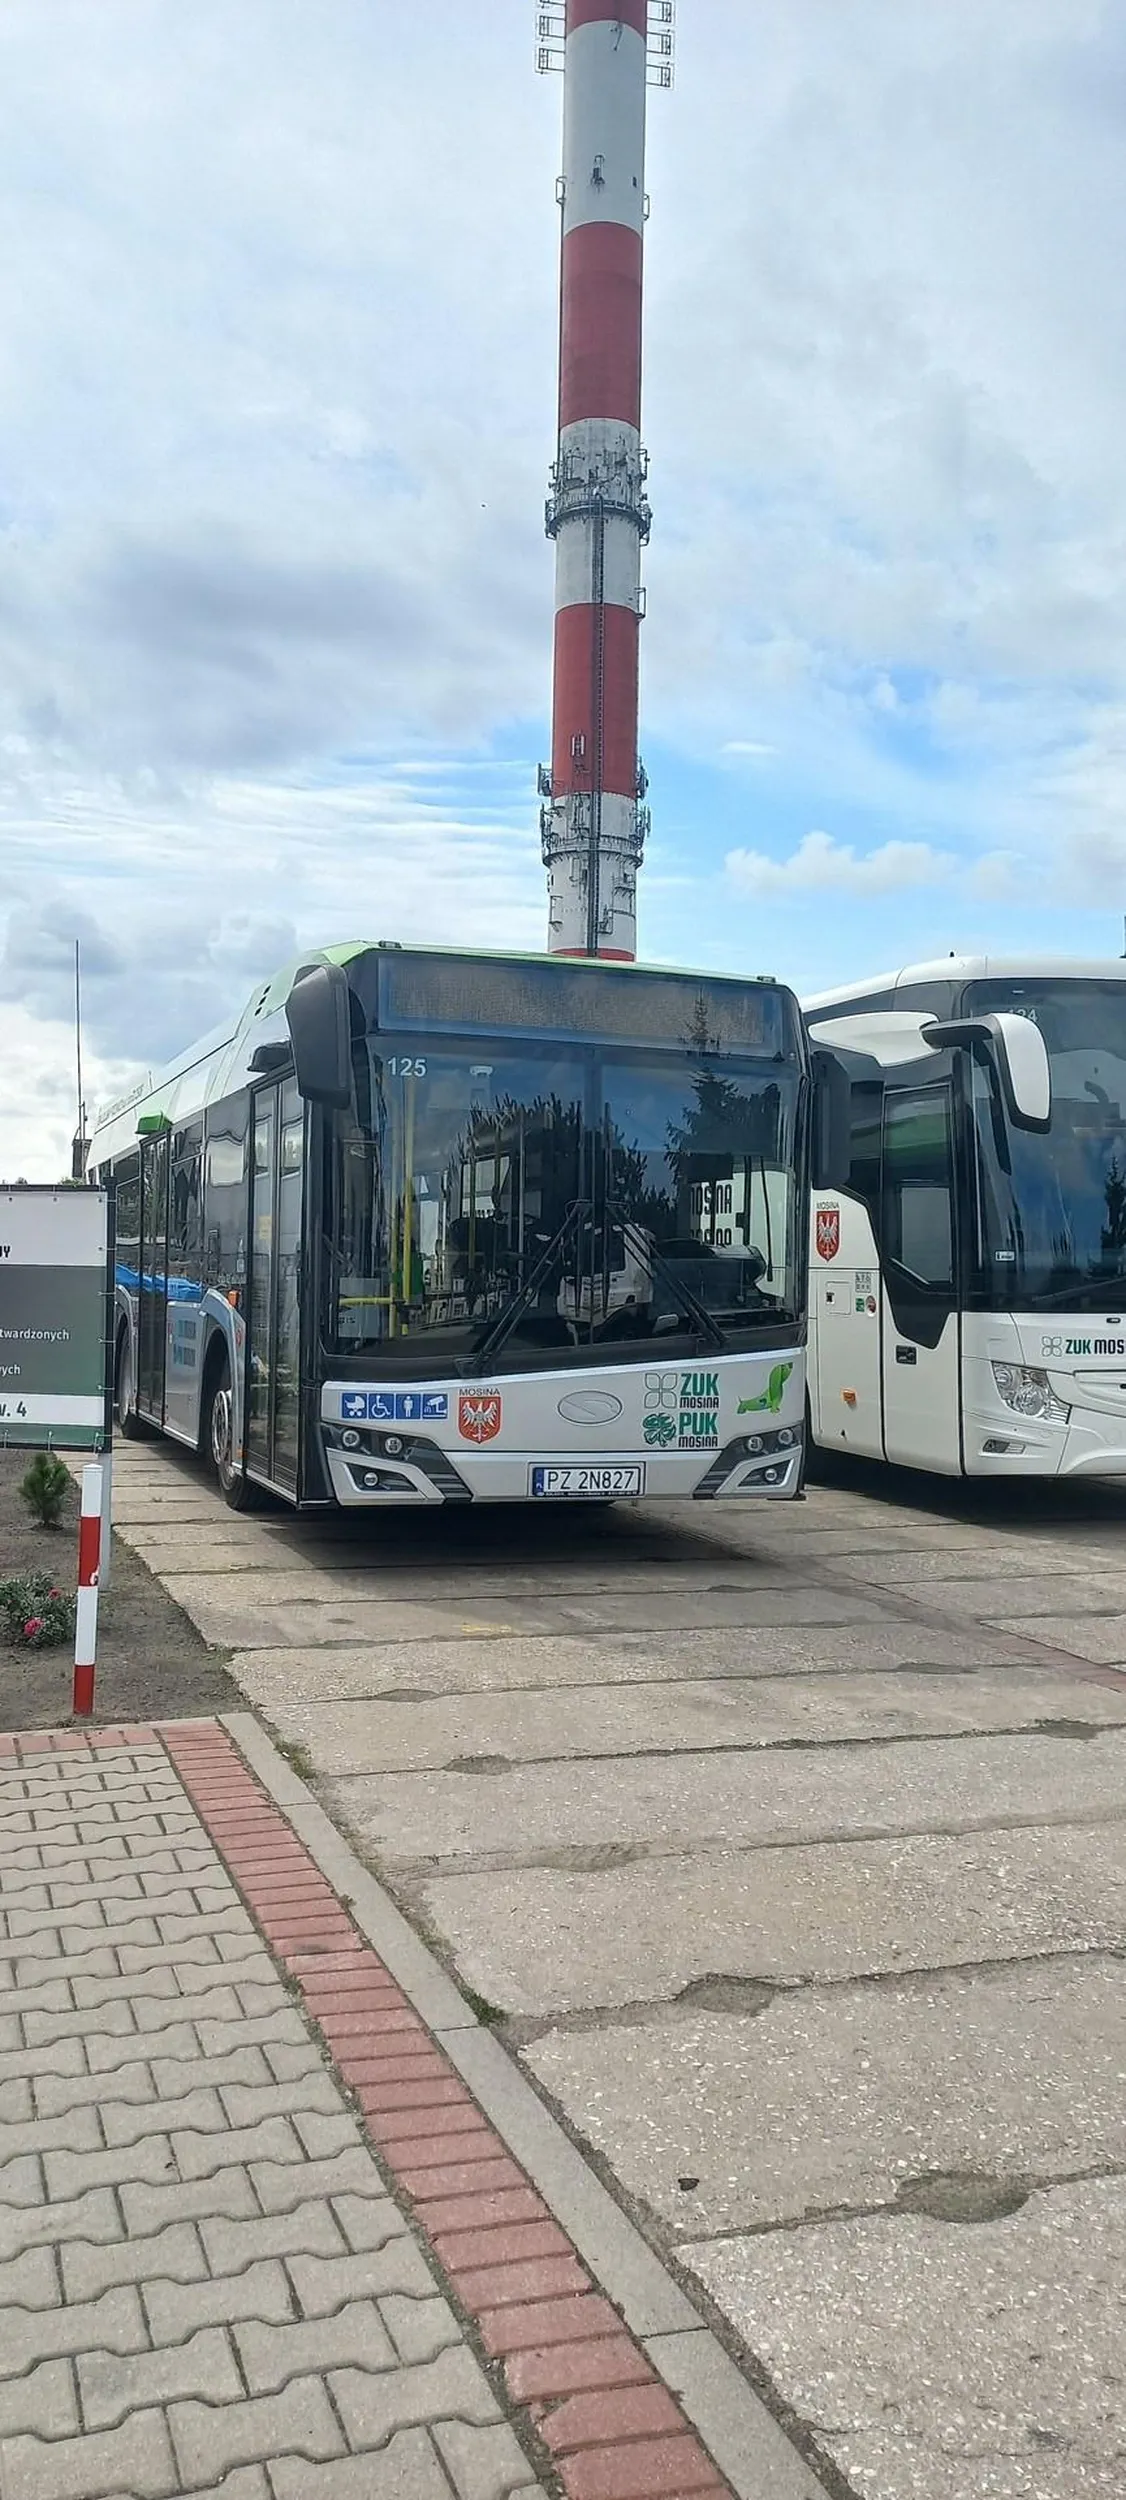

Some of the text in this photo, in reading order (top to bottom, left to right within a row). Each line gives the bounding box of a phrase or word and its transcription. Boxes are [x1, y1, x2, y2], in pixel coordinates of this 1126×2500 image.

[388, 1057, 427, 1077] 125
[1065, 1339, 1092, 1355] ZUK
[0, 1364, 21, 1377] ych
[459, 1387, 501, 1396] MOSINA
[680, 1373, 719, 1396] ZUK
[16, 1400, 27, 1417] 4
[679, 1396, 719, 1409] MOSINA
[679, 1412, 718, 1435] PUK
[678, 1436, 718, 1448] MOSINA
[547, 1471, 634, 1490] PZ 2N827
